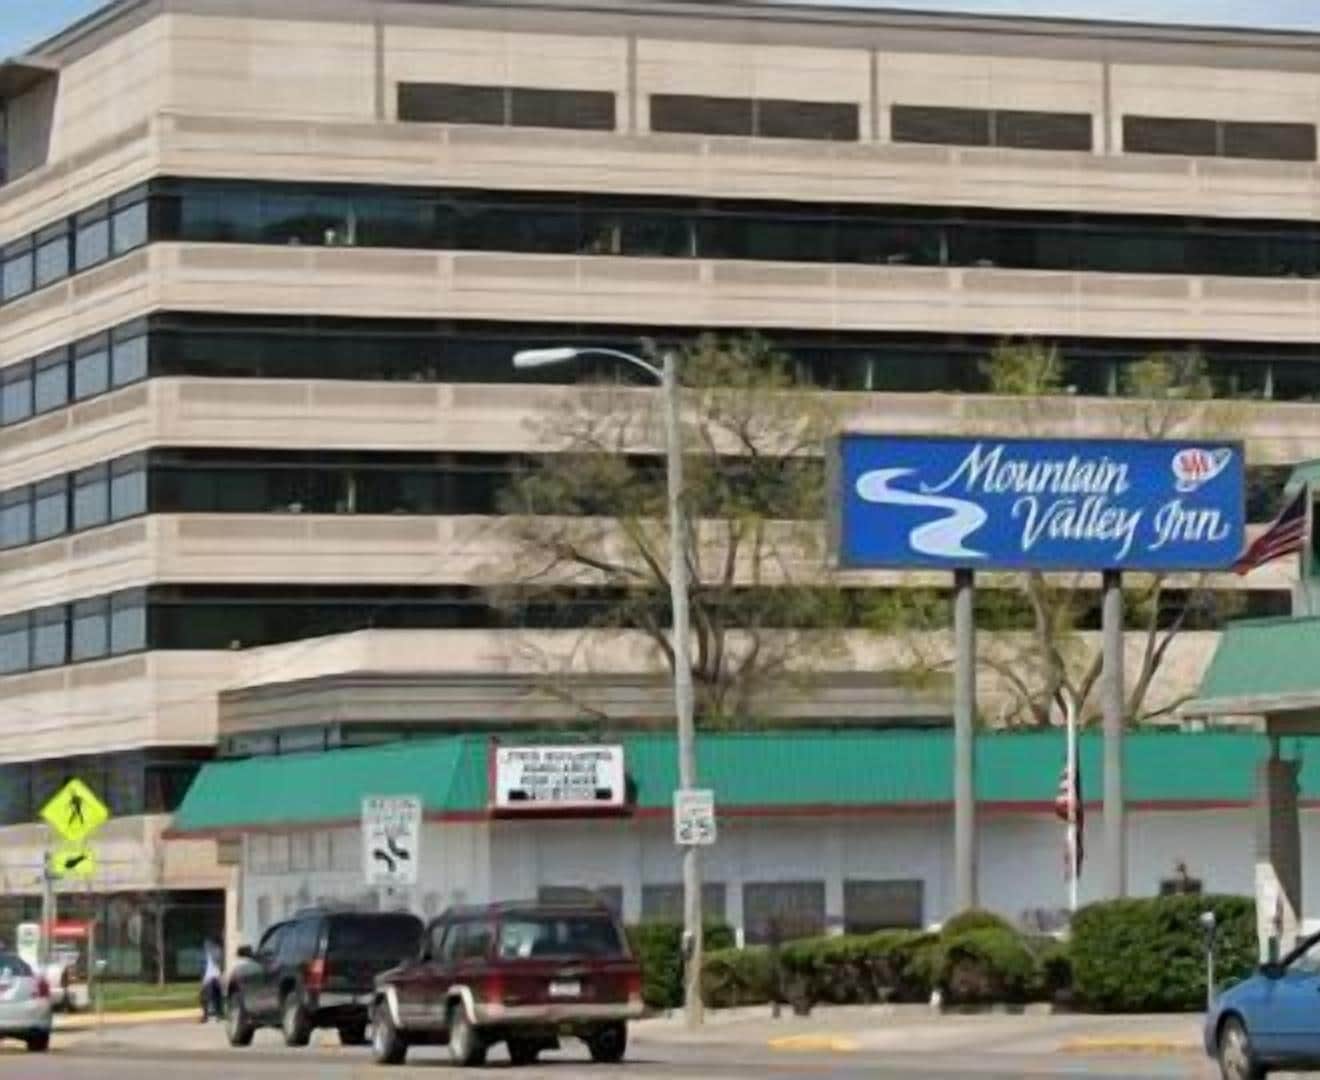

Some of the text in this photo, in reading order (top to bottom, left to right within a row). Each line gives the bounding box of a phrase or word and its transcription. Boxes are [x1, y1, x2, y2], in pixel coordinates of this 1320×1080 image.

[919, 442, 1130, 495] Mountain
[1010, 496, 1231, 560] Valley Inn
